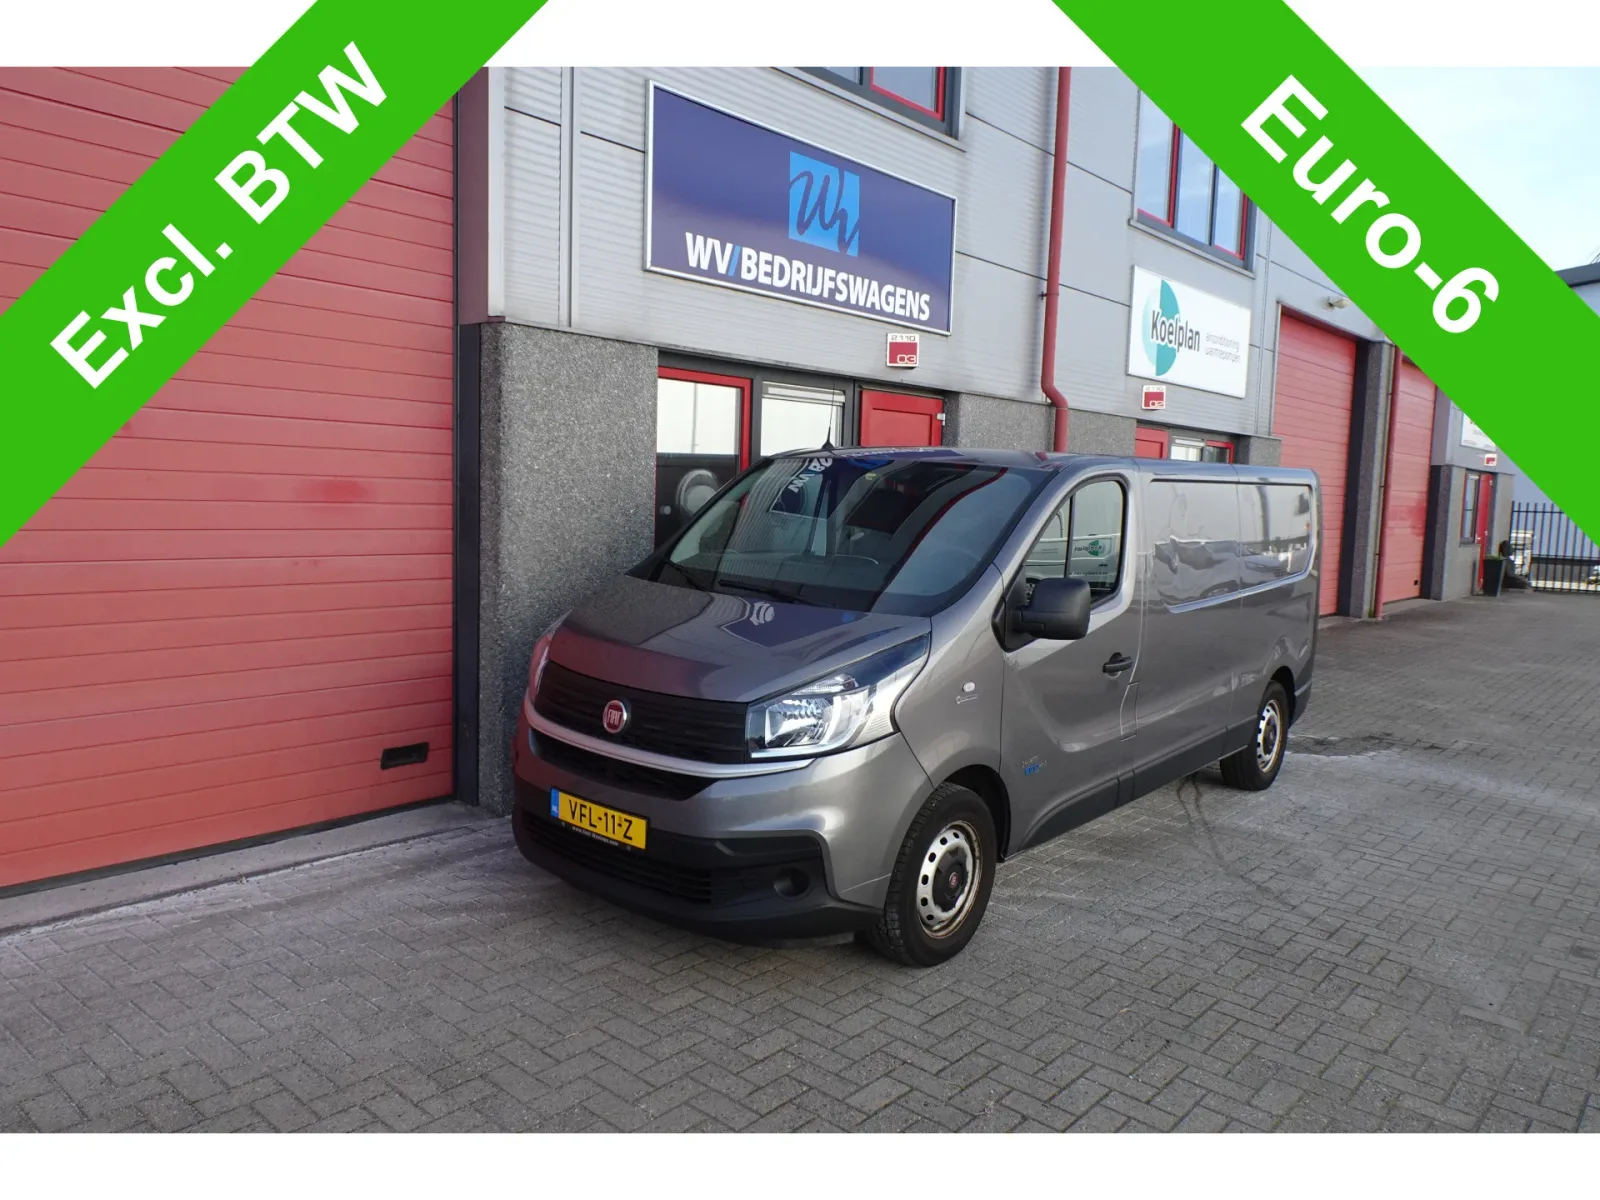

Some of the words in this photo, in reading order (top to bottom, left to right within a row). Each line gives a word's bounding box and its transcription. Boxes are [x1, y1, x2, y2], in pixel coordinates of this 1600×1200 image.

[1150, 309, 1201, 353] Koelplan
[897, 354, 917, 364] 03
[607, 708, 622, 725] FIAT
[568, 799, 634, 842] VFL-11-Z
